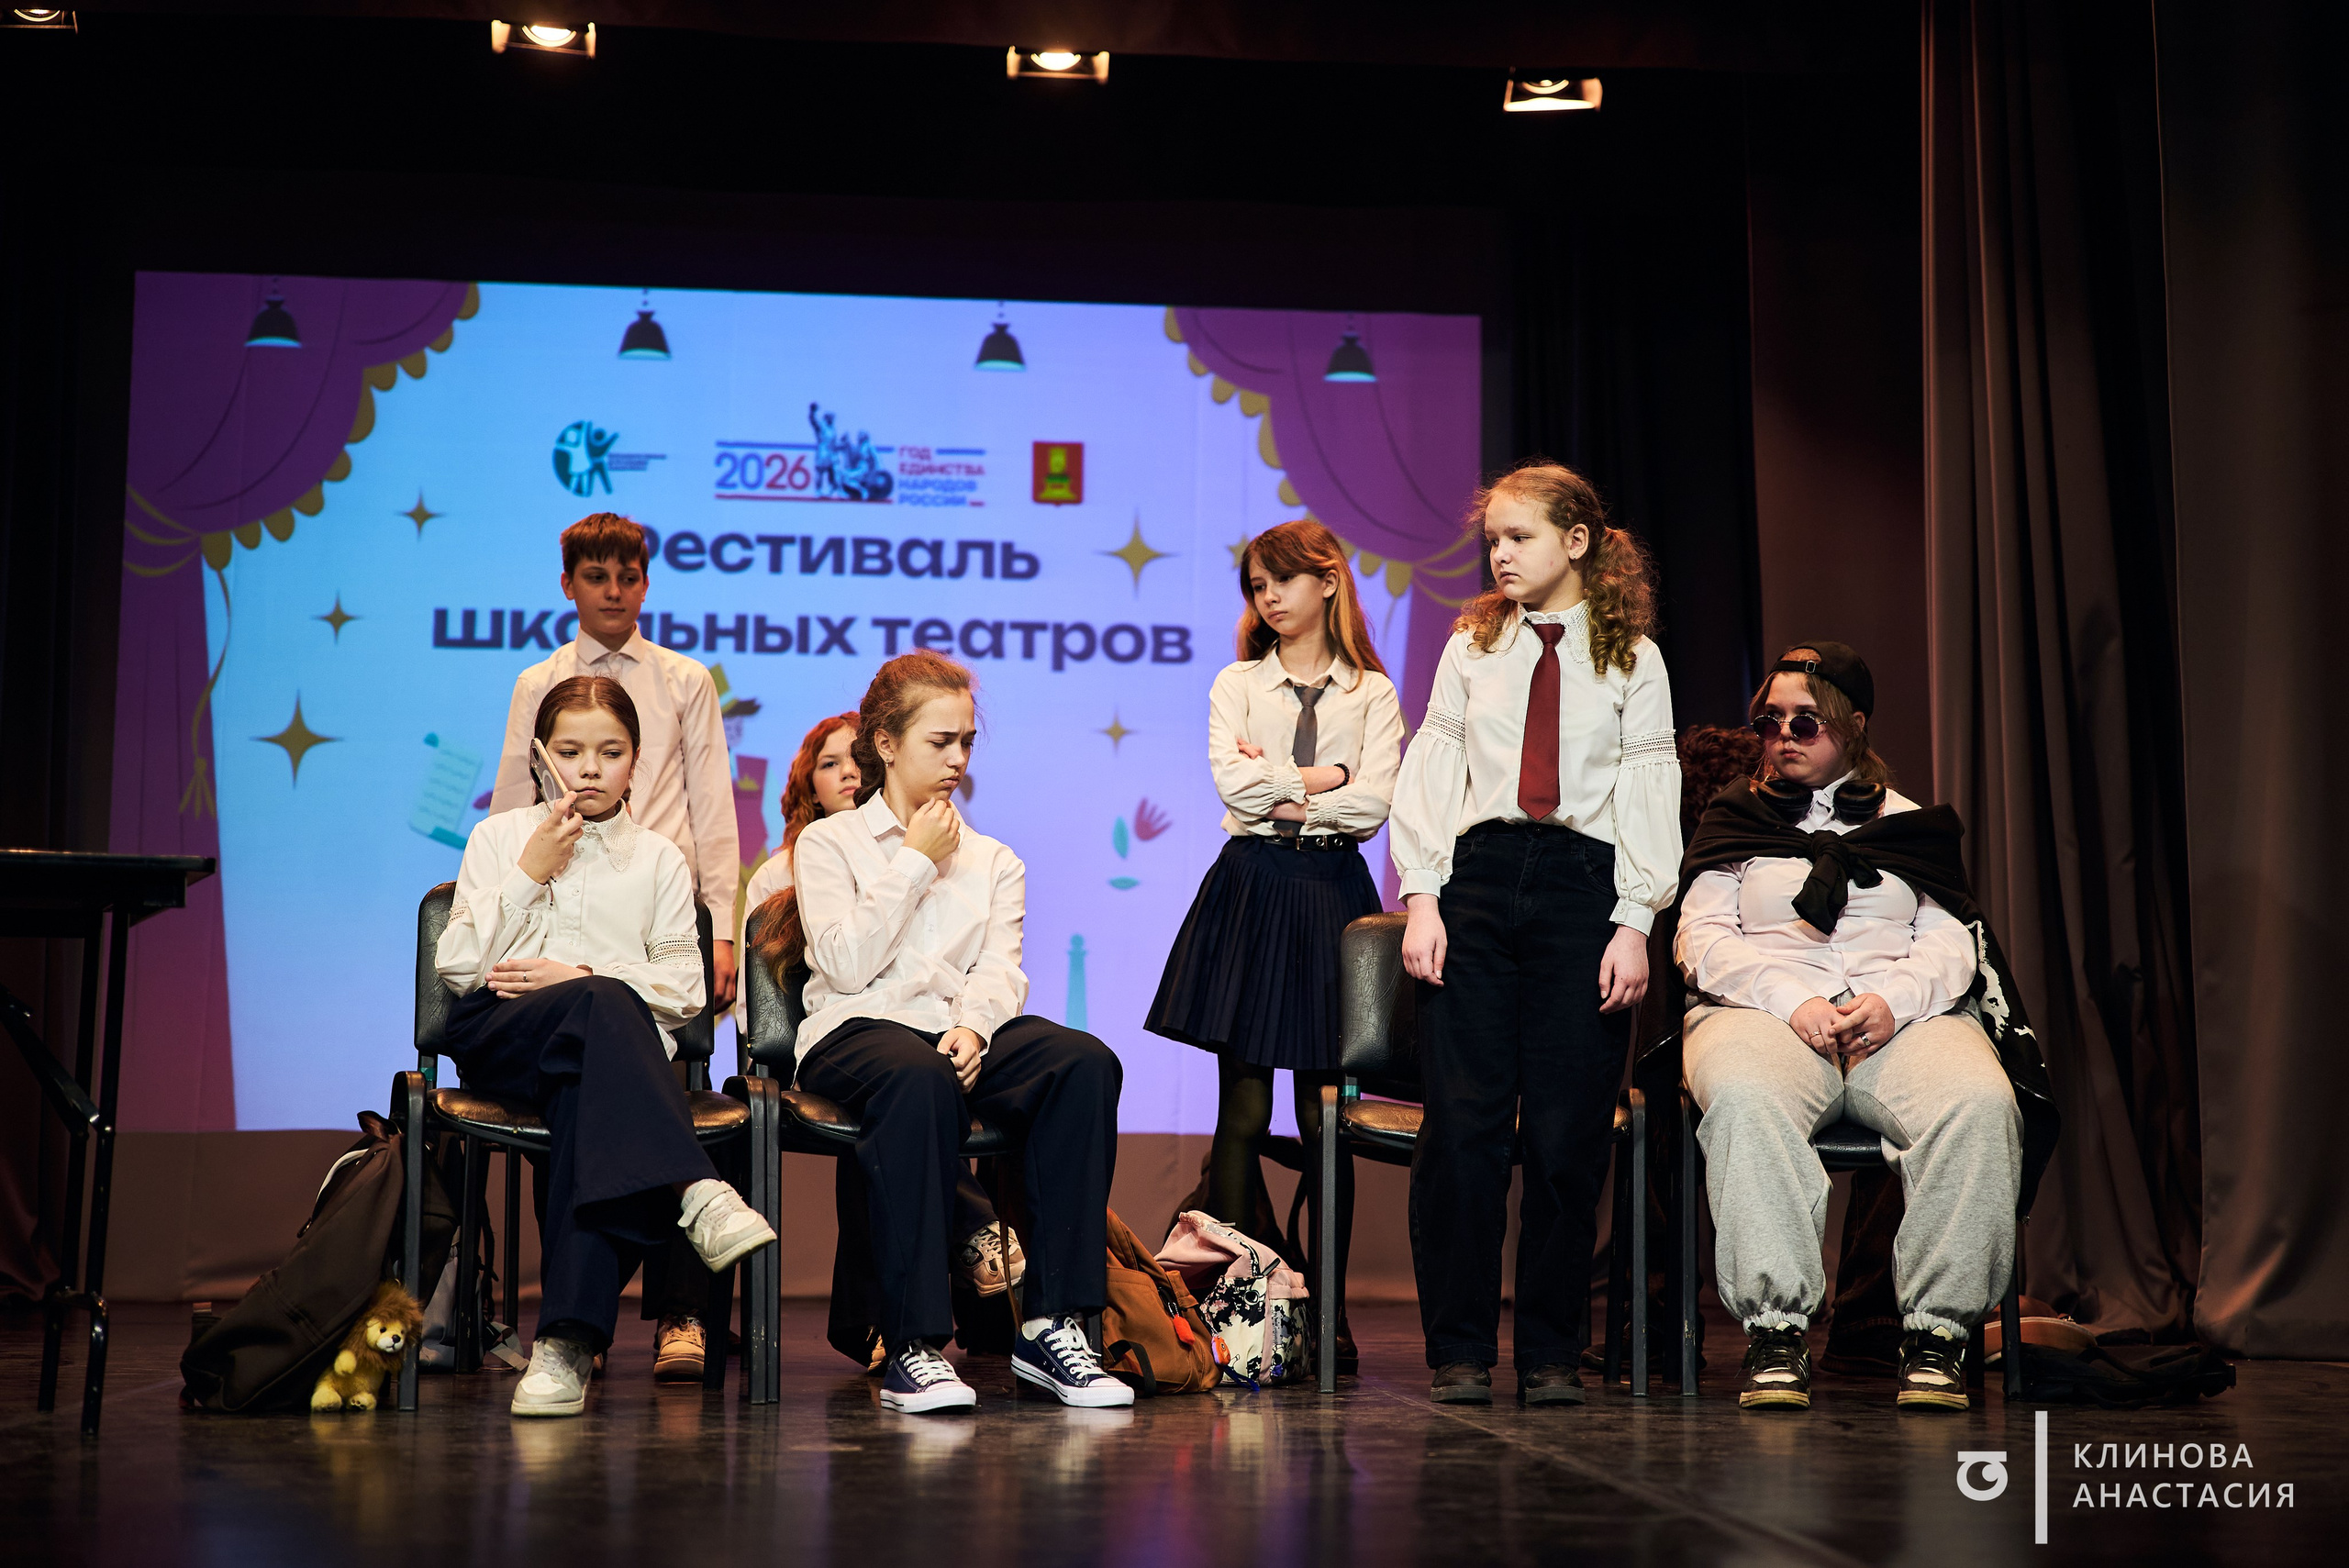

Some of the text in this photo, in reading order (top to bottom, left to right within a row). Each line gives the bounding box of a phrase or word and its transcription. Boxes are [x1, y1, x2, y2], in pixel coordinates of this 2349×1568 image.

[714, 451, 811, 490] 2026
[642, 525, 1041, 580] естиваль
[871, 616, 1193, 673] театров
